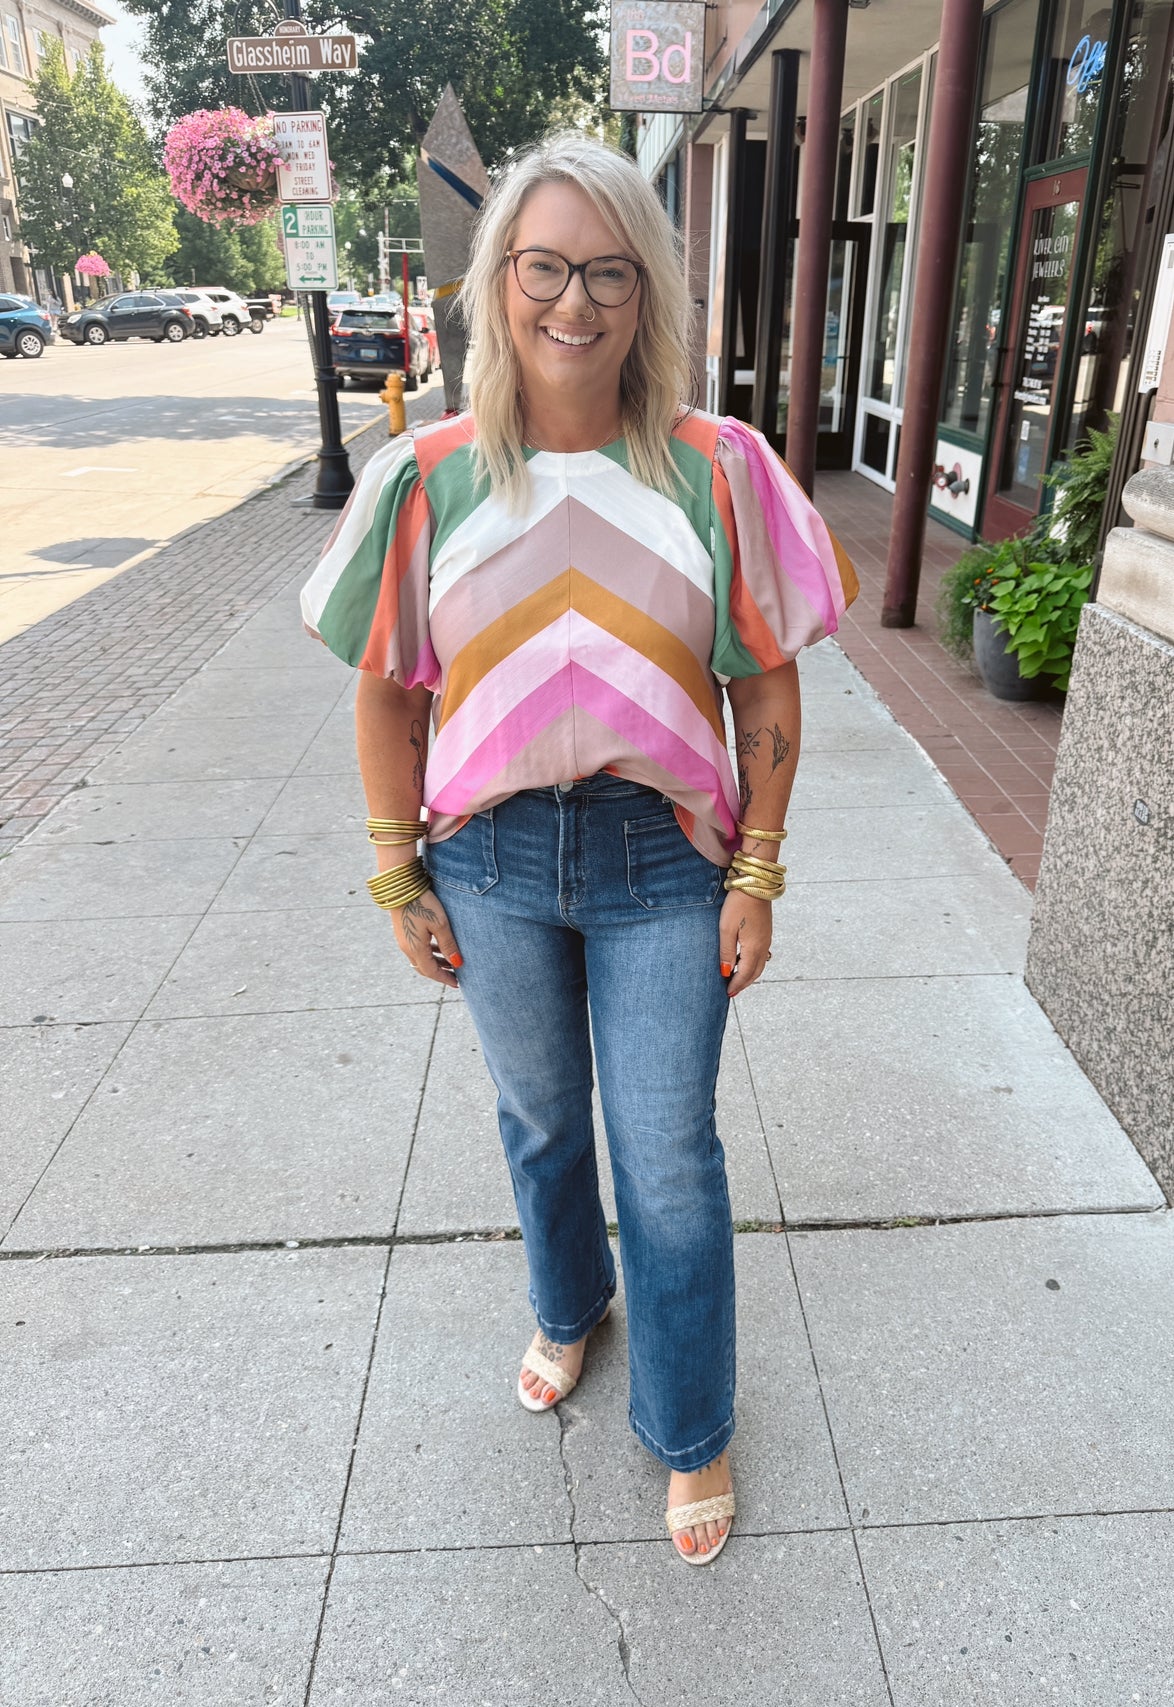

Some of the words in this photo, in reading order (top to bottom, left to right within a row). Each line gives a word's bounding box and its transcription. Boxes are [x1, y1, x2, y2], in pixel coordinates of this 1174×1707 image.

[233, 40, 310, 67] Glassheim
[320, 38, 351, 67] Way
[626, 29, 692, 84] Bd
[276, 121, 287, 133] NO
[291, 119, 322, 133] PARKING
[296, 162, 315, 171] FRIDAY
[294, 176, 313, 185] STREET
[292, 187, 319, 196] CLEANING
[305, 210, 323, 221] HOUR
[285, 212, 297, 233] 2
[302, 224, 328, 235] PARKING
[316, 240, 325, 249] AM
[306, 251, 314, 260] TO
[317, 262, 328, 271] PM
